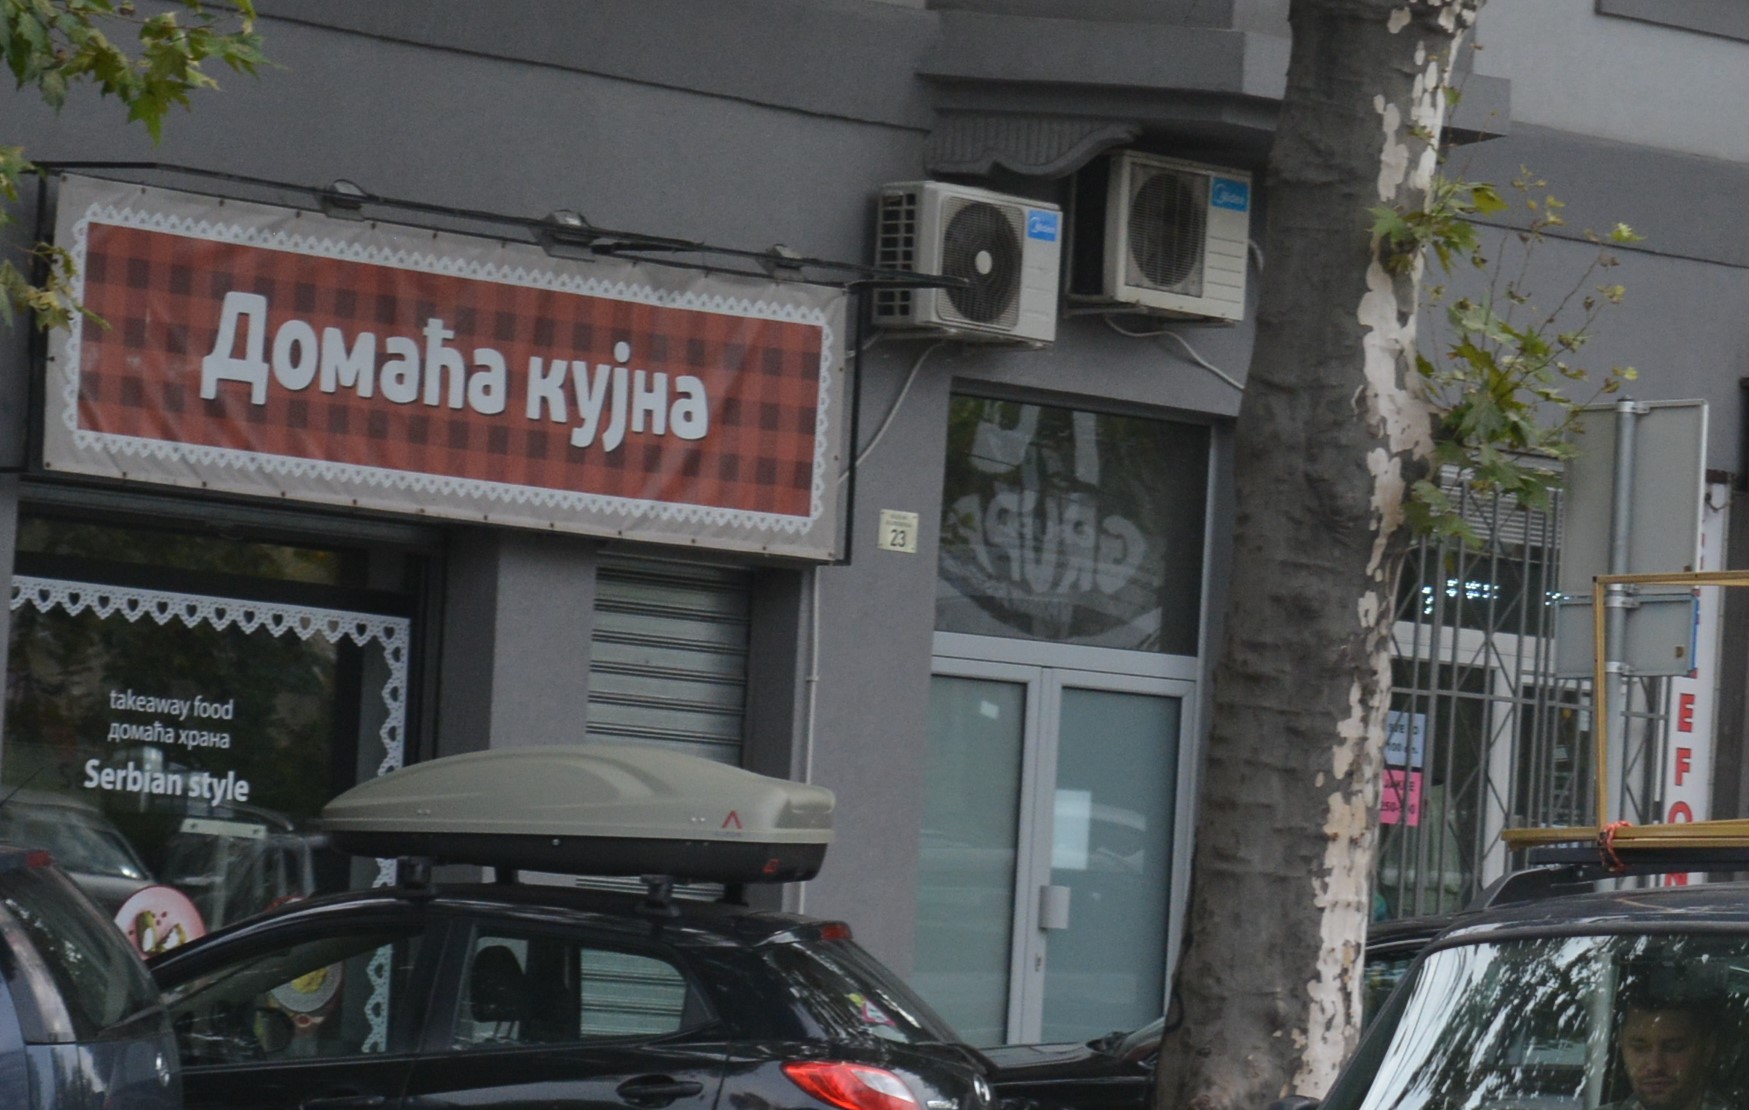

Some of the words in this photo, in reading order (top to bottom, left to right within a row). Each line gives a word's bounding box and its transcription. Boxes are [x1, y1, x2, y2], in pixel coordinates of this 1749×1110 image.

[200, 291, 506, 415] Домаћа
[526, 341, 709, 452] кујна
[890, 529, 906, 547] 23
[109, 689, 191, 721] takeaway
[193, 695, 234, 720] food
[107, 720, 175, 743] домаћа
[178, 729, 231, 750] храна
[83, 758, 183, 796] Serbian
[188, 770, 250, 807] style
